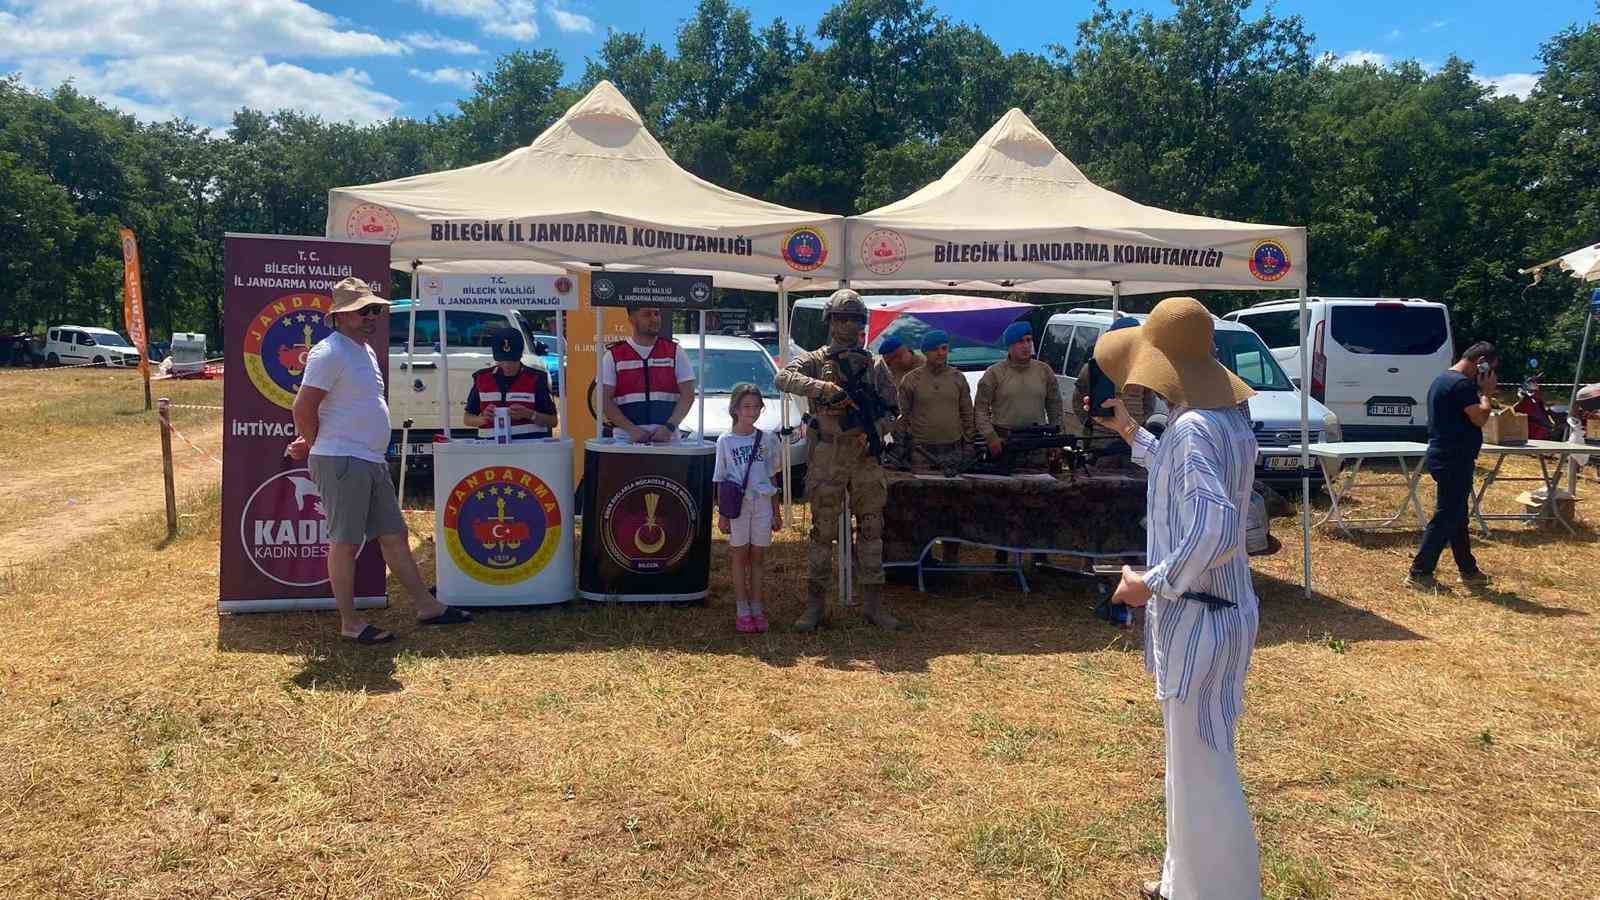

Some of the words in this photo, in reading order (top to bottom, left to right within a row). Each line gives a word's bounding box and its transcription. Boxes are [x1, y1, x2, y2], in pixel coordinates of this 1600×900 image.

[431, 221, 503, 242] BİLECİK
[509, 220, 524, 242] İL
[528, 223, 628, 245] JANDARMA
[632, 227, 752, 256] KOMUTANLIĞI
[934, 241, 1000, 262] BİLECİK
[1003, 240, 1018, 262] İL
[1021, 242, 1109, 263] JANDARMA
[1113, 245, 1224, 268] KOMUTANLIĞI
[264, 261, 306, 275] BİLECİK
[234, 275, 244, 286] İL
[246, 277, 307, 290] JANDARMA
[462, 286, 497, 295] BİLECİK
[498, 286, 536, 295] VALİLİĞİ
[438, 297, 445, 305] İL
[447, 297, 498, 306] JANDARMA
[500, 297, 560, 306] KOMUTANLIĞI
[448, 470, 557, 514] JANDARMA
[254, 519, 330, 545] KADE
